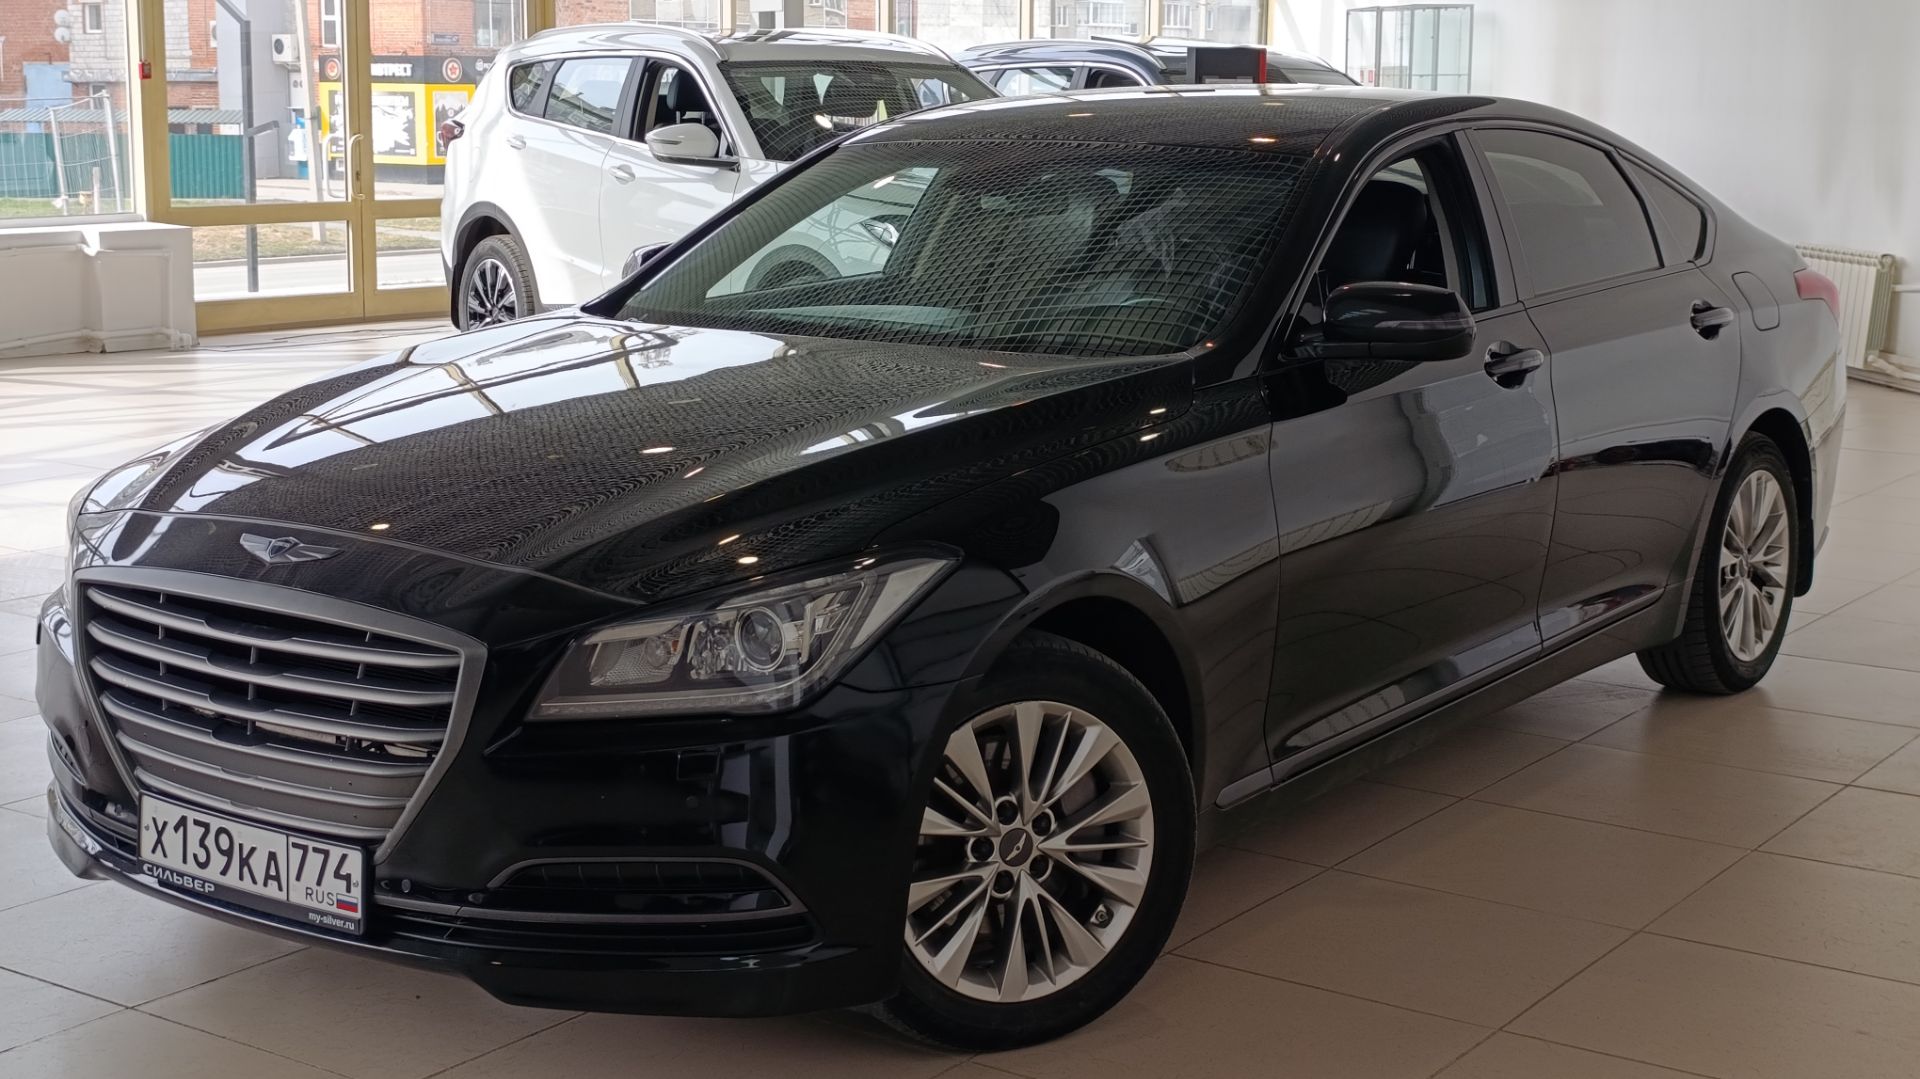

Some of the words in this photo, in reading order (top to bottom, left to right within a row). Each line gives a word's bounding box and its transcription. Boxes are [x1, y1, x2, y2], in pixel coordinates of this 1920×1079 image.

[151, 815, 284, 892] Х139КА
[291, 841, 352, 894] 774
[142, 863, 216, 893] СИЛЬВЕР
[305, 886, 335, 907] RUS
[308, 911, 355, 931] my-silver.ru
